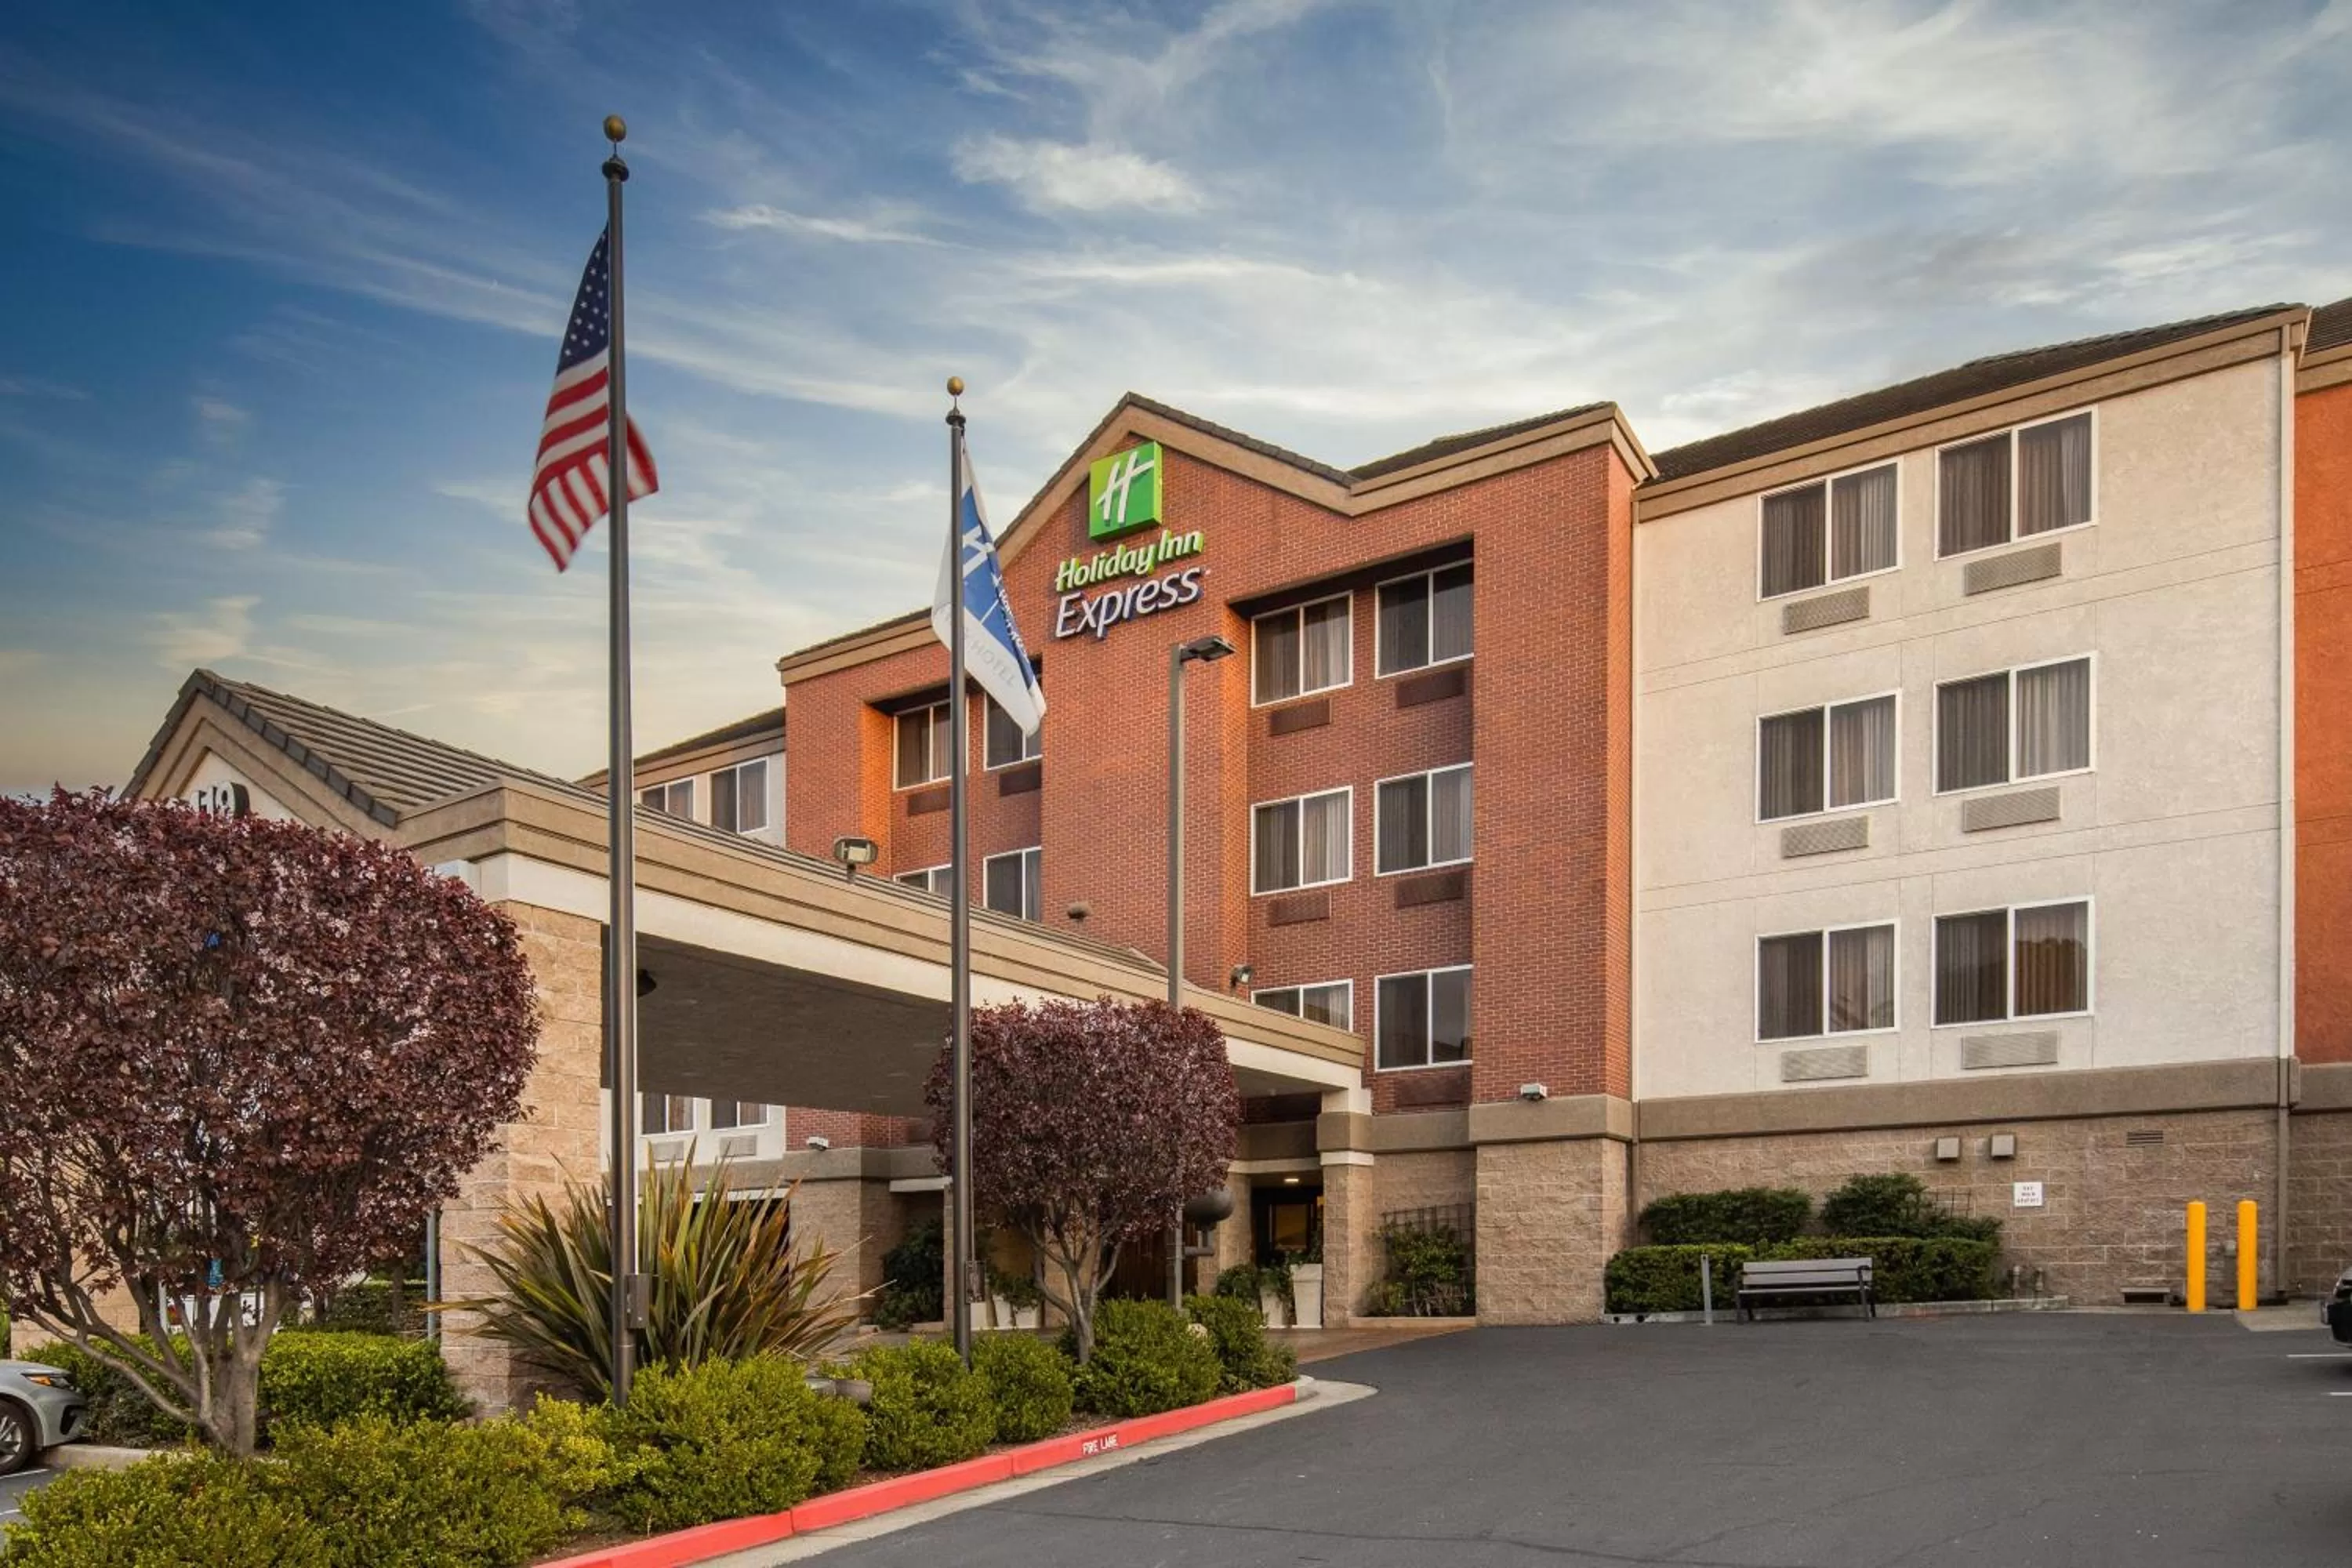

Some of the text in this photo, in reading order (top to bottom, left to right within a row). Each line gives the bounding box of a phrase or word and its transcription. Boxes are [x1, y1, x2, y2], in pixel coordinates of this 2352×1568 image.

[1054, 529, 1204, 592] Holiday Inn
[1055, 567, 1202, 638] Express
